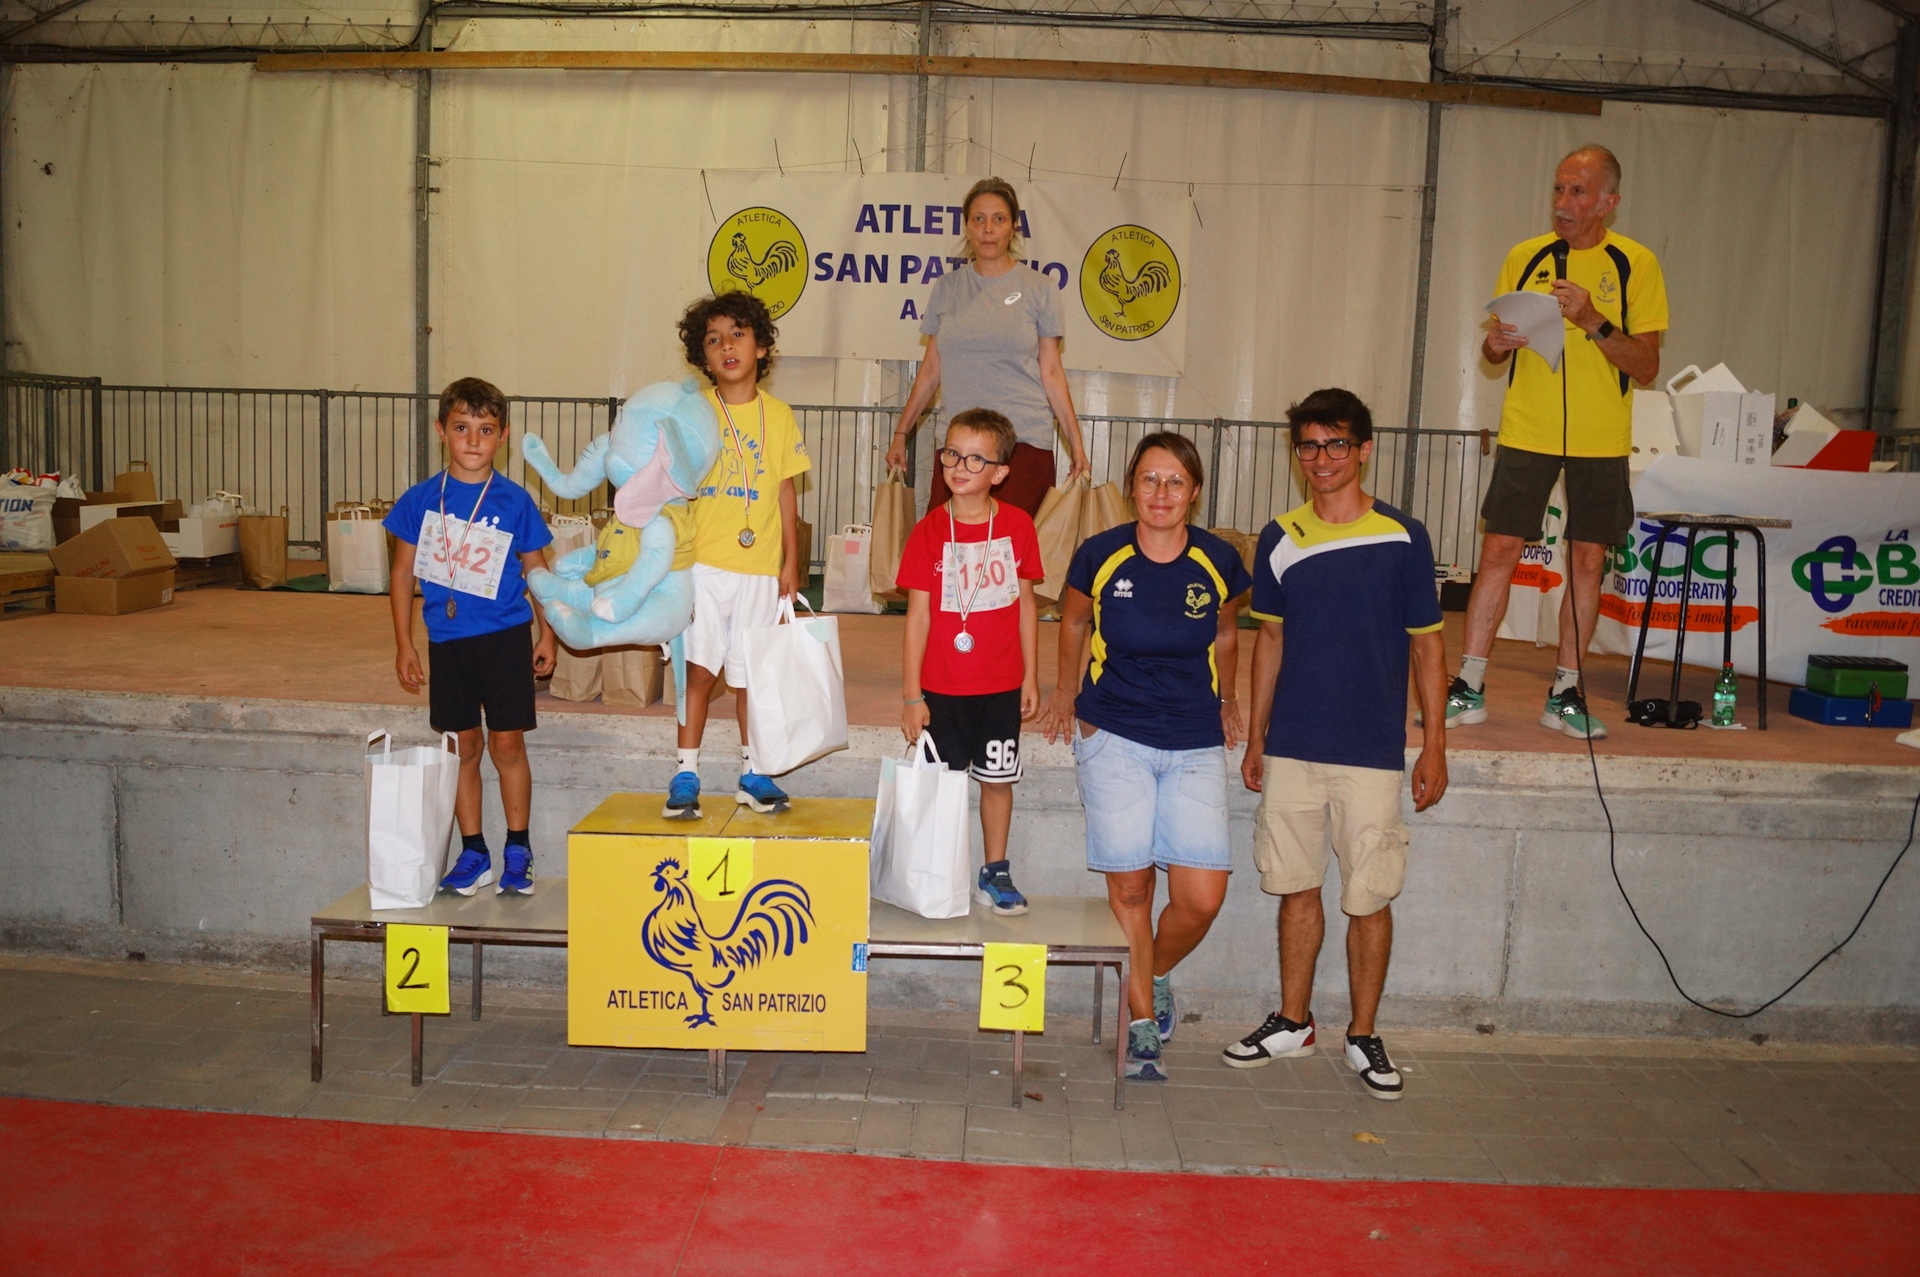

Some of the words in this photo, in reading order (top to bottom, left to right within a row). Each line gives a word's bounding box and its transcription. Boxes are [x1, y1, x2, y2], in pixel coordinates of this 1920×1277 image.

[737, 213, 782, 227] ATLETICA
[855, 204, 1031, 239] ATLETA
[1111, 231, 1155, 247] ATLETICA
[814, 252, 889, 284] SAN
[900, 255, 1069, 291] PATIO
[1099, 314, 1116, 331] SAN
[1115, 320, 1155, 334] PATRIZIO
[1884, 529, 1909, 542] LA
[76, 557, 110, 578] FROLLINI
[433, 536, 491, 575] 342
[959, 560, 1005, 590] 130
[1613, 573, 1649, 597] CREDITO
[1113, 590, 1133, 598] errea
[1845, 618, 1909, 631] ravennate
[986, 739, 1016, 770] 96
[707, 847, 736, 897] 1
[397, 947, 430, 990] 2
[997, 965, 1030, 1009] 3
[607, 989, 689, 1011] ATLETICA
[722, 992, 753, 1012] SAN
[758, 993, 827, 1013] PATRIZIO
